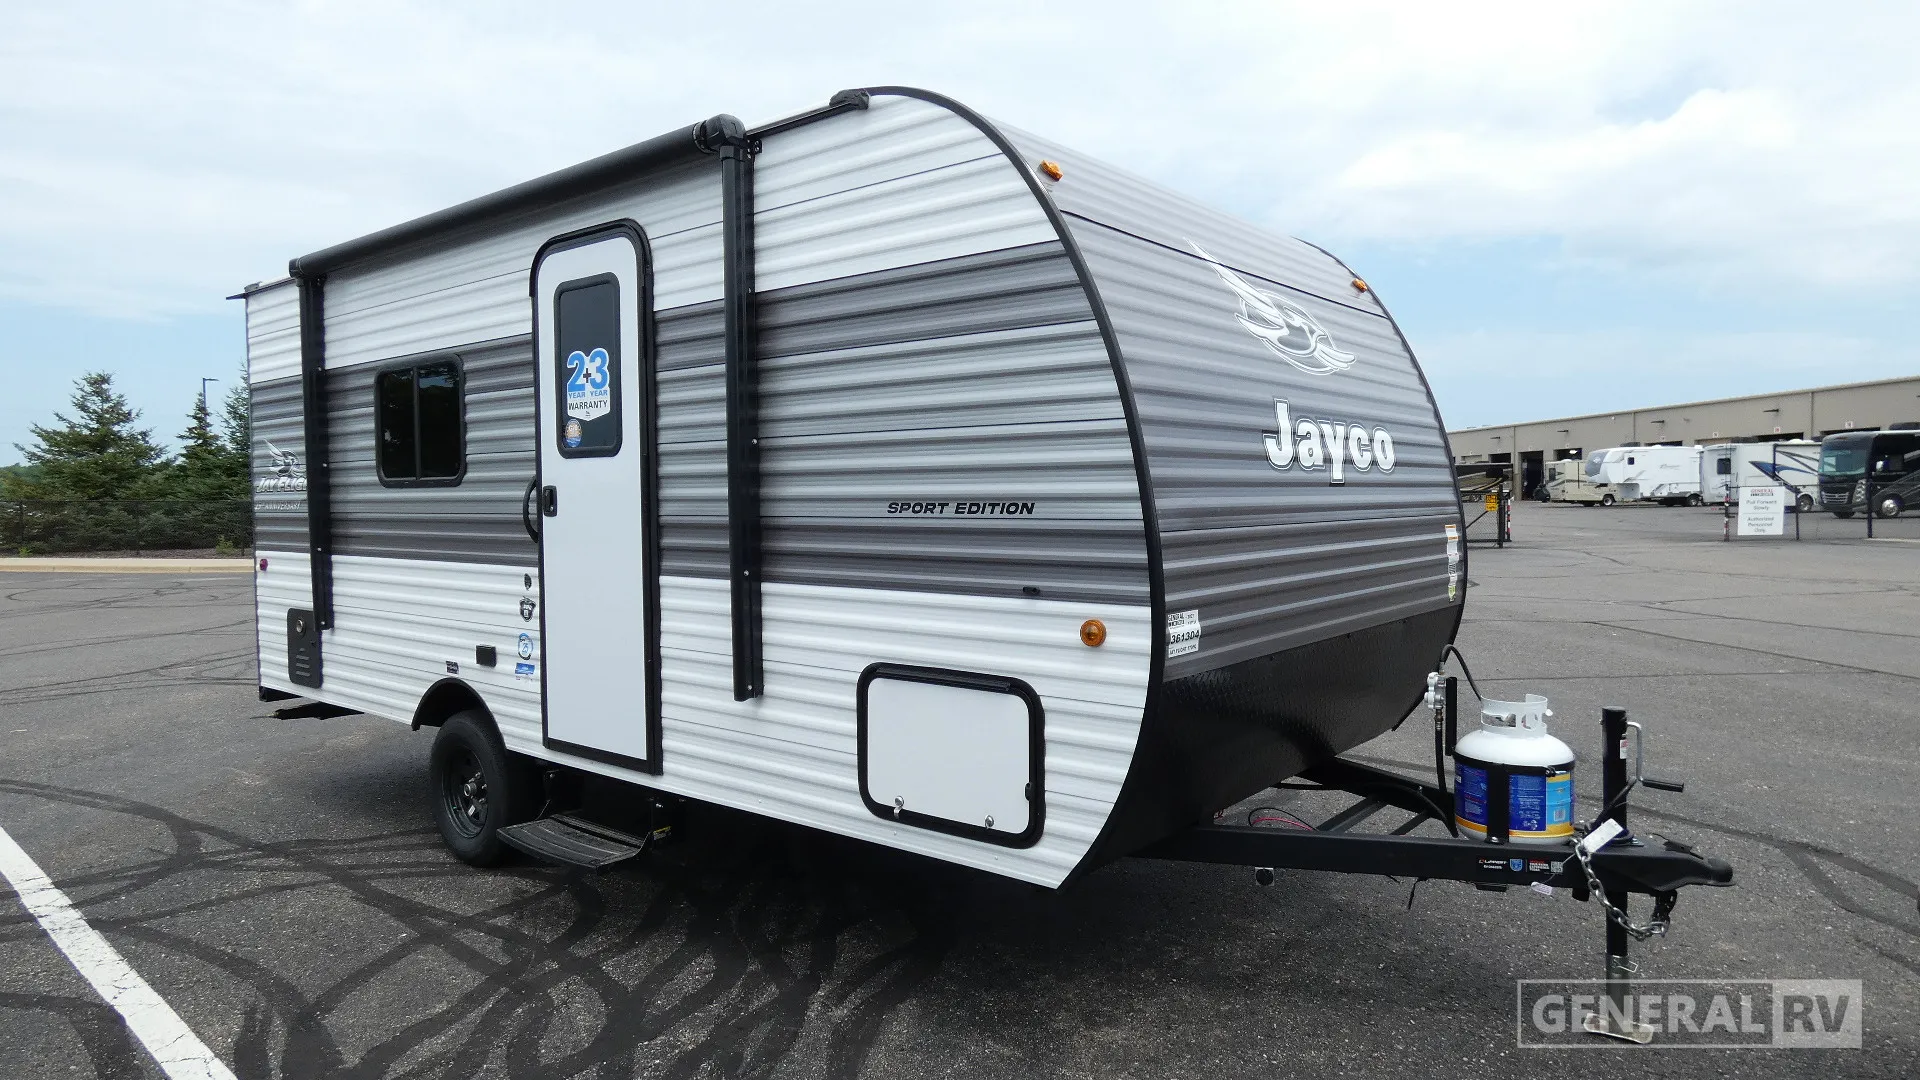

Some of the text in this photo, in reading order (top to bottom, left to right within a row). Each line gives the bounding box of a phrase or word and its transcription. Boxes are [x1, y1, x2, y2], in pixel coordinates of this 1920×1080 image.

[568, 389, 608, 399] YEAR YEAR
[568, 400, 608, 411] WARRANTY
[1262, 398, 1397, 484] Jayco
[887, 501, 1036, 515] SPORT EDITION
[1170, 629, 1200, 645] 361304
